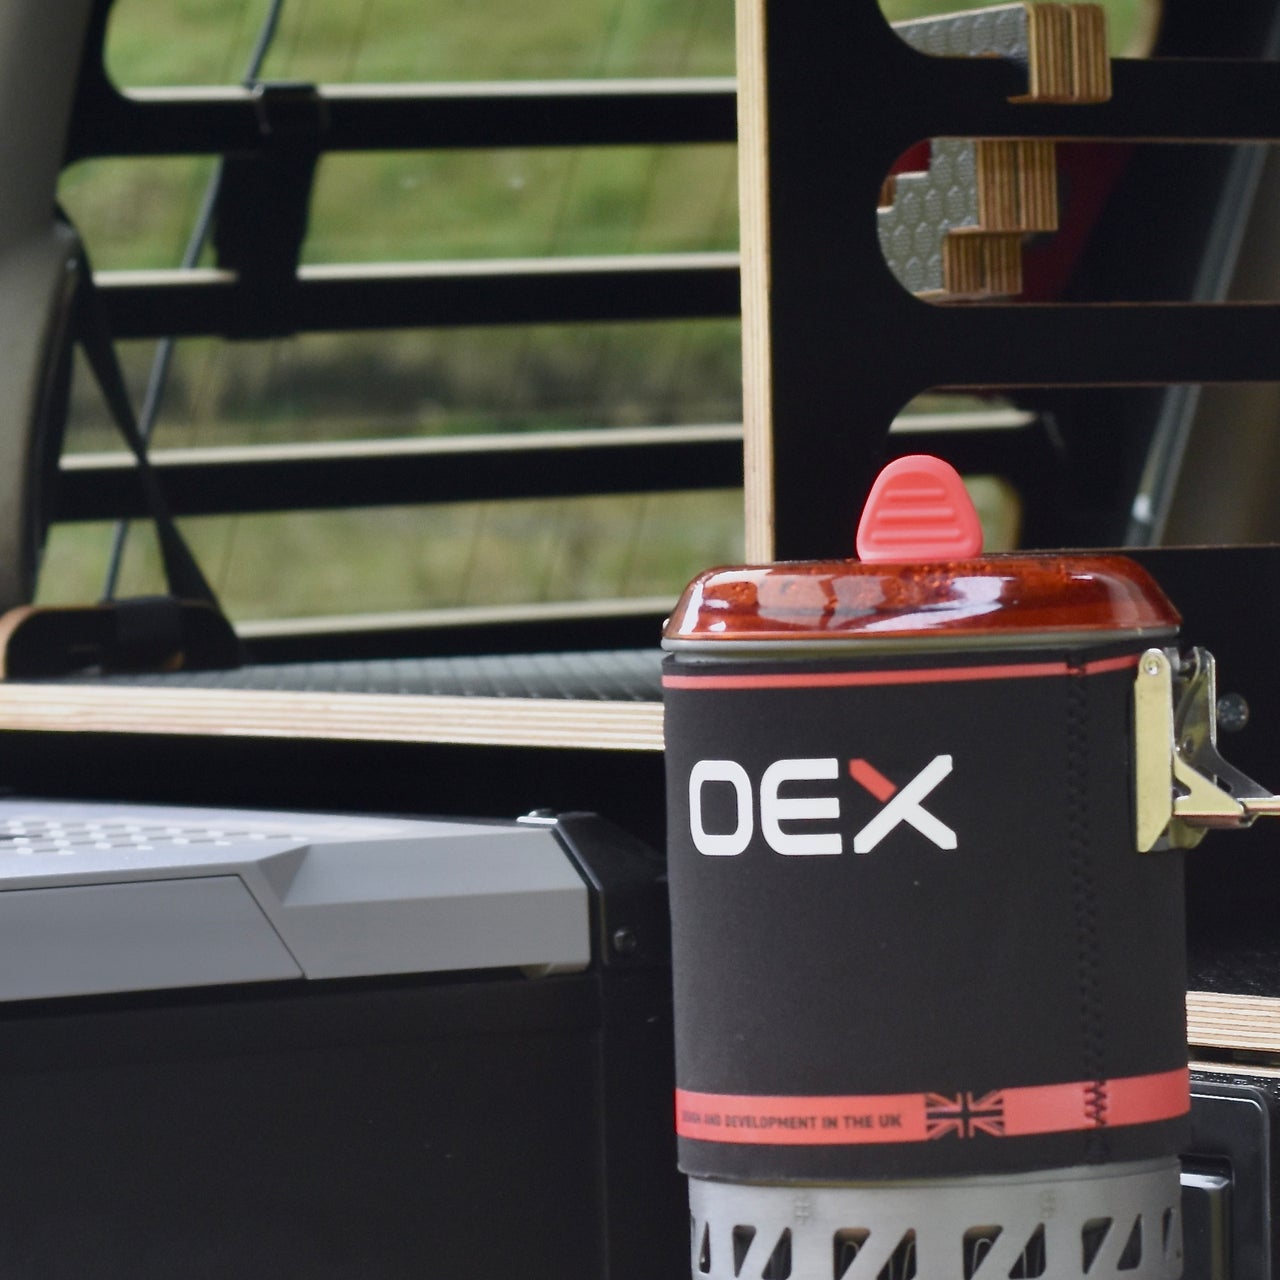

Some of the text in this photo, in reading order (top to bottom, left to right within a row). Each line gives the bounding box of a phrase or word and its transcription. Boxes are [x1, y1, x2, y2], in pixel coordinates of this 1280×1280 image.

[688, 753, 958, 856] OEX
[724, 1113, 817, 1129] DEVELOPMENT
[822, 1115, 838, 1129] IN
[843, 1114, 873, 1129] THE
[878, 1113, 902, 1129] UK
